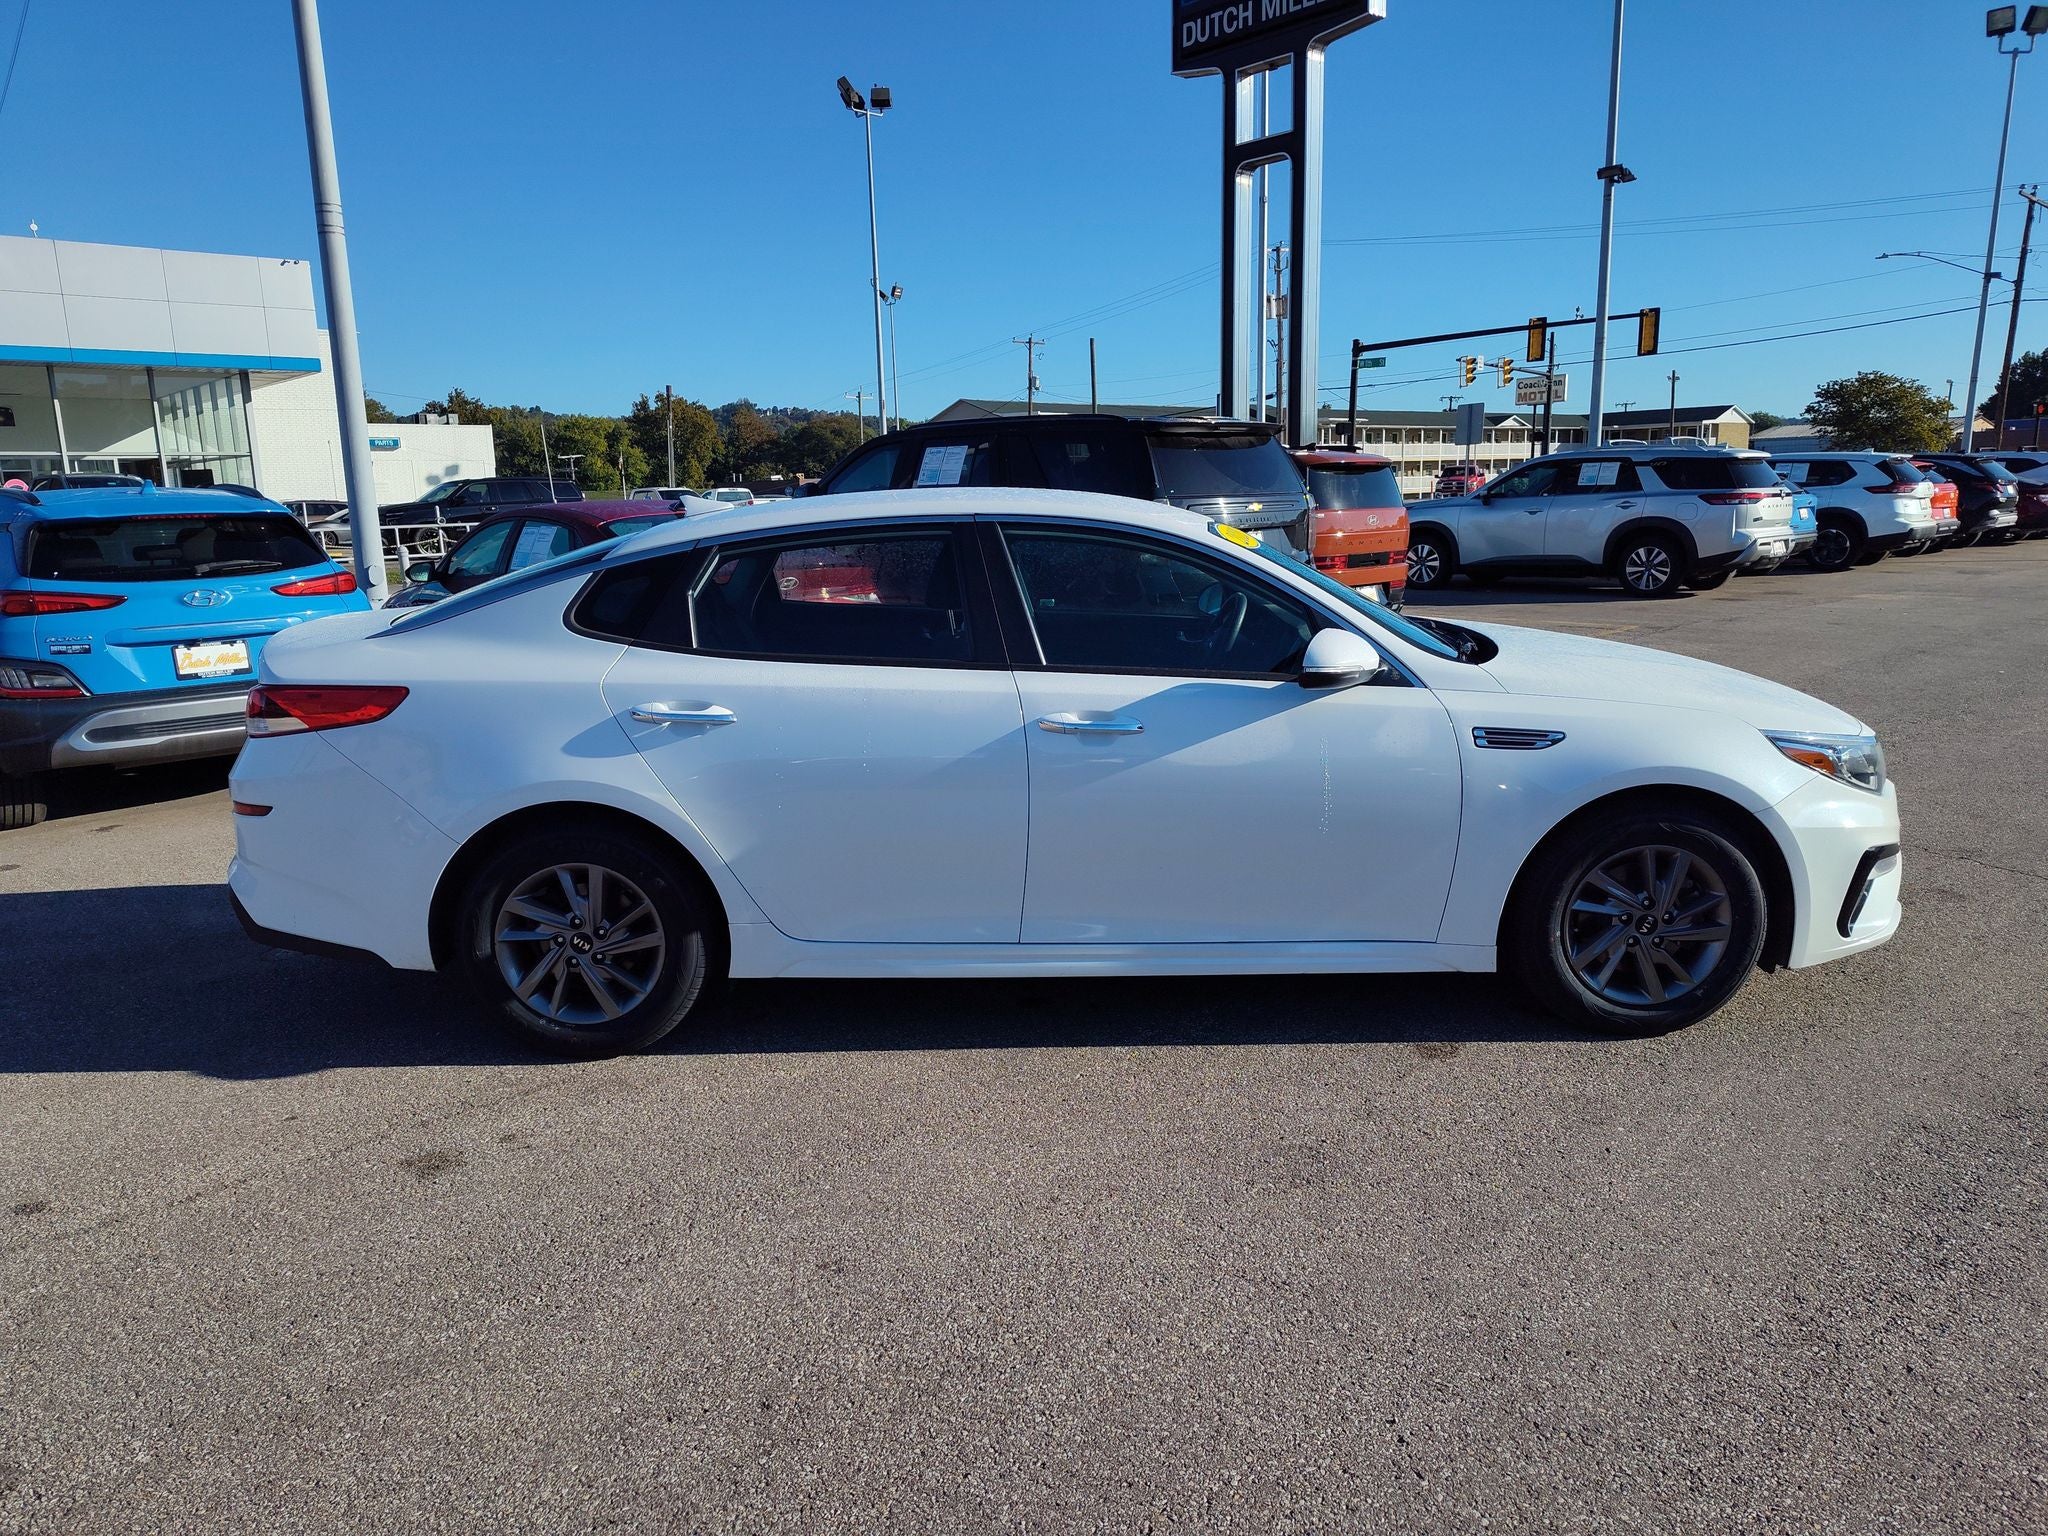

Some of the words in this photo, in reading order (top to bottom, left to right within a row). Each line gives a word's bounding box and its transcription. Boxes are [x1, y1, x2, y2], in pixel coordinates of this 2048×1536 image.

[1182, 1, 1253, 48] DUTCH
[1261, 0, 1325, 21] MIL
[1517, 389, 1562, 402] MOTL
[1639, 916, 1654, 933] KIA
[573, 936, 590, 951] KIA
